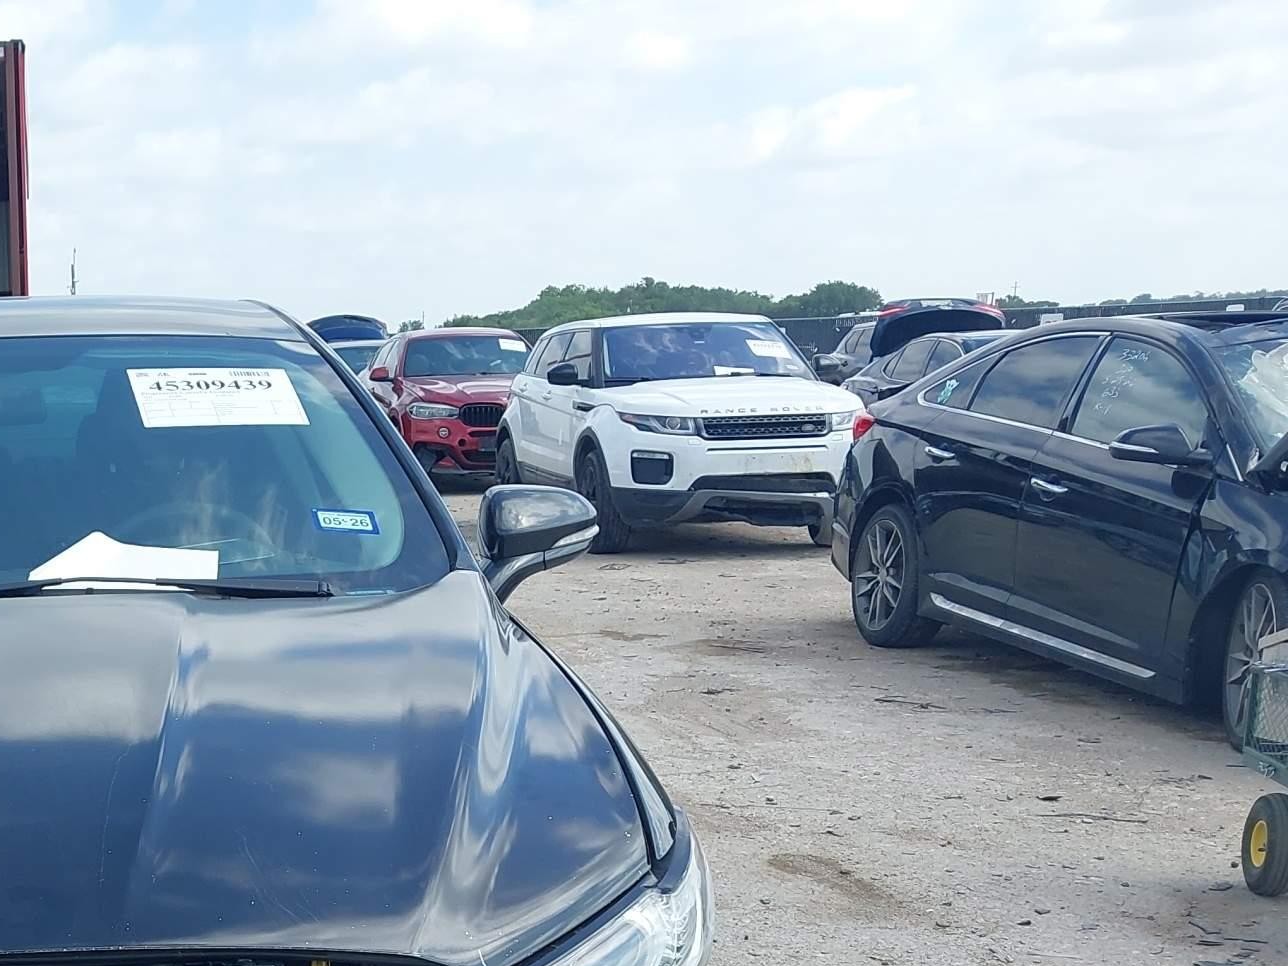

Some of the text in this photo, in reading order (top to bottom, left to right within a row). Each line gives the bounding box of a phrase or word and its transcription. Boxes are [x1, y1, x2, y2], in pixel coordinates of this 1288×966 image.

[149, 379, 273, 392] 45309439
[700, 407, 758, 415] RANGE
[322, 516, 370, 528] 05-26
